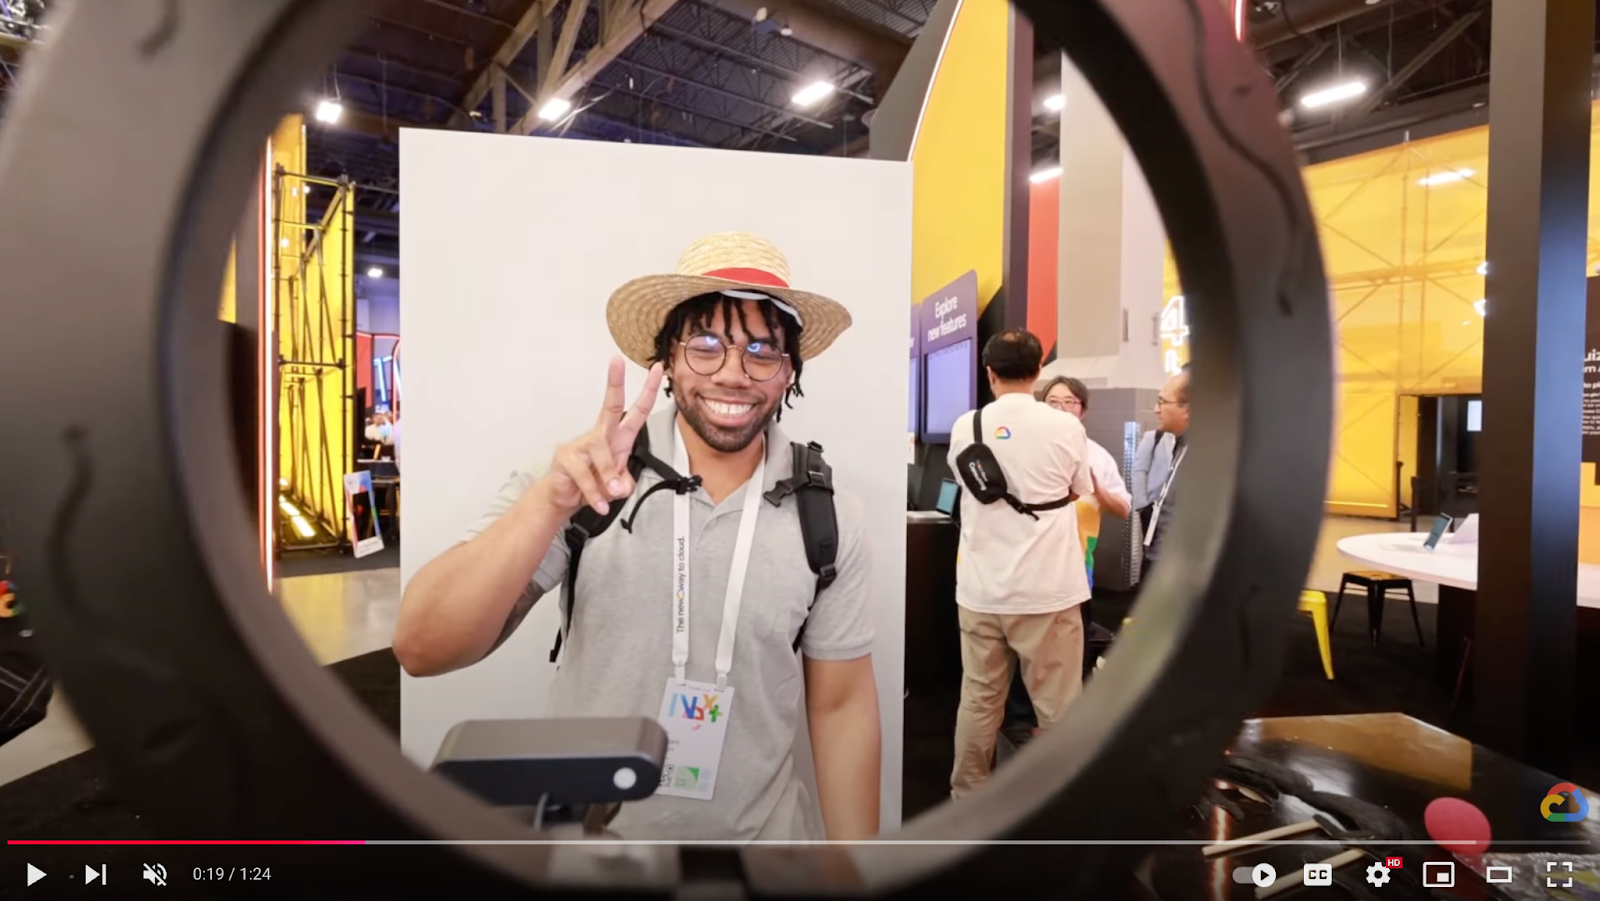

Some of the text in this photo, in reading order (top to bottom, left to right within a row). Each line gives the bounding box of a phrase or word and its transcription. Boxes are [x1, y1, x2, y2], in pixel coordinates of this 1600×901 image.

[935, 296, 958, 322] Explore
[928, 313, 967, 342] new features
[1583, 349, 1600, 361] uiz
[677, 536, 685, 561] cloud.
[678, 562, 685, 572] to
[676, 618, 684, 633] The
